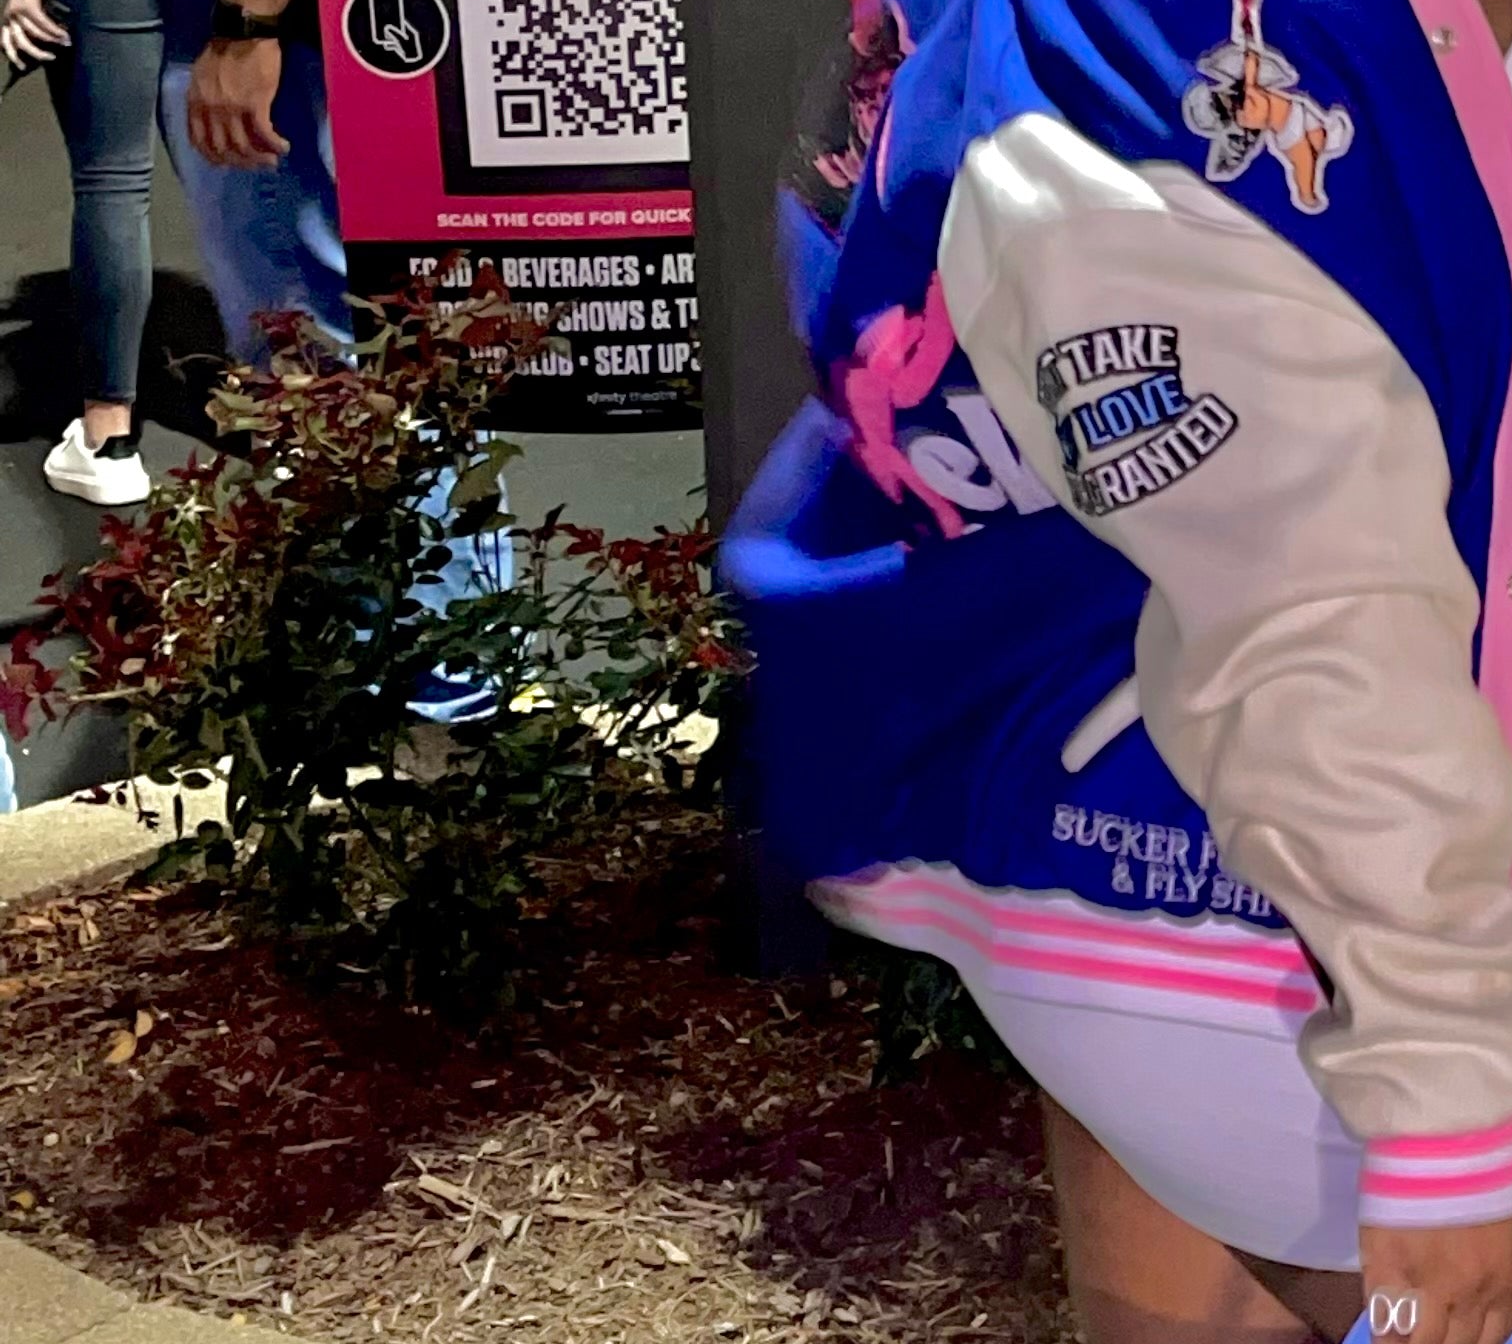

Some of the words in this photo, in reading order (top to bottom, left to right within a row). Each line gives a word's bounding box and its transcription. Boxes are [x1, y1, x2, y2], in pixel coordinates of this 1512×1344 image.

[437, 212, 488, 227] SCAN
[492, 212, 528, 227] THE
[532, 211, 584, 226] CODE
[589, 210, 626, 225] FOR
[631, 208, 692, 224] QUICK
[502, 256, 640, 288] BEVERAGES
[557, 300, 645, 332] SHOWS
[651, 299, 671, 329] &
[594, 344, 651, 375] SEAT
[1060, 326, 1177, 380] TAKE
[1079, 373, 1191, 446] LOVE
[1052, 803, 1190, 867] SUCKER
[1111, 856, 1134, 894] &
[1146, 863, 1207, 903] FLY
